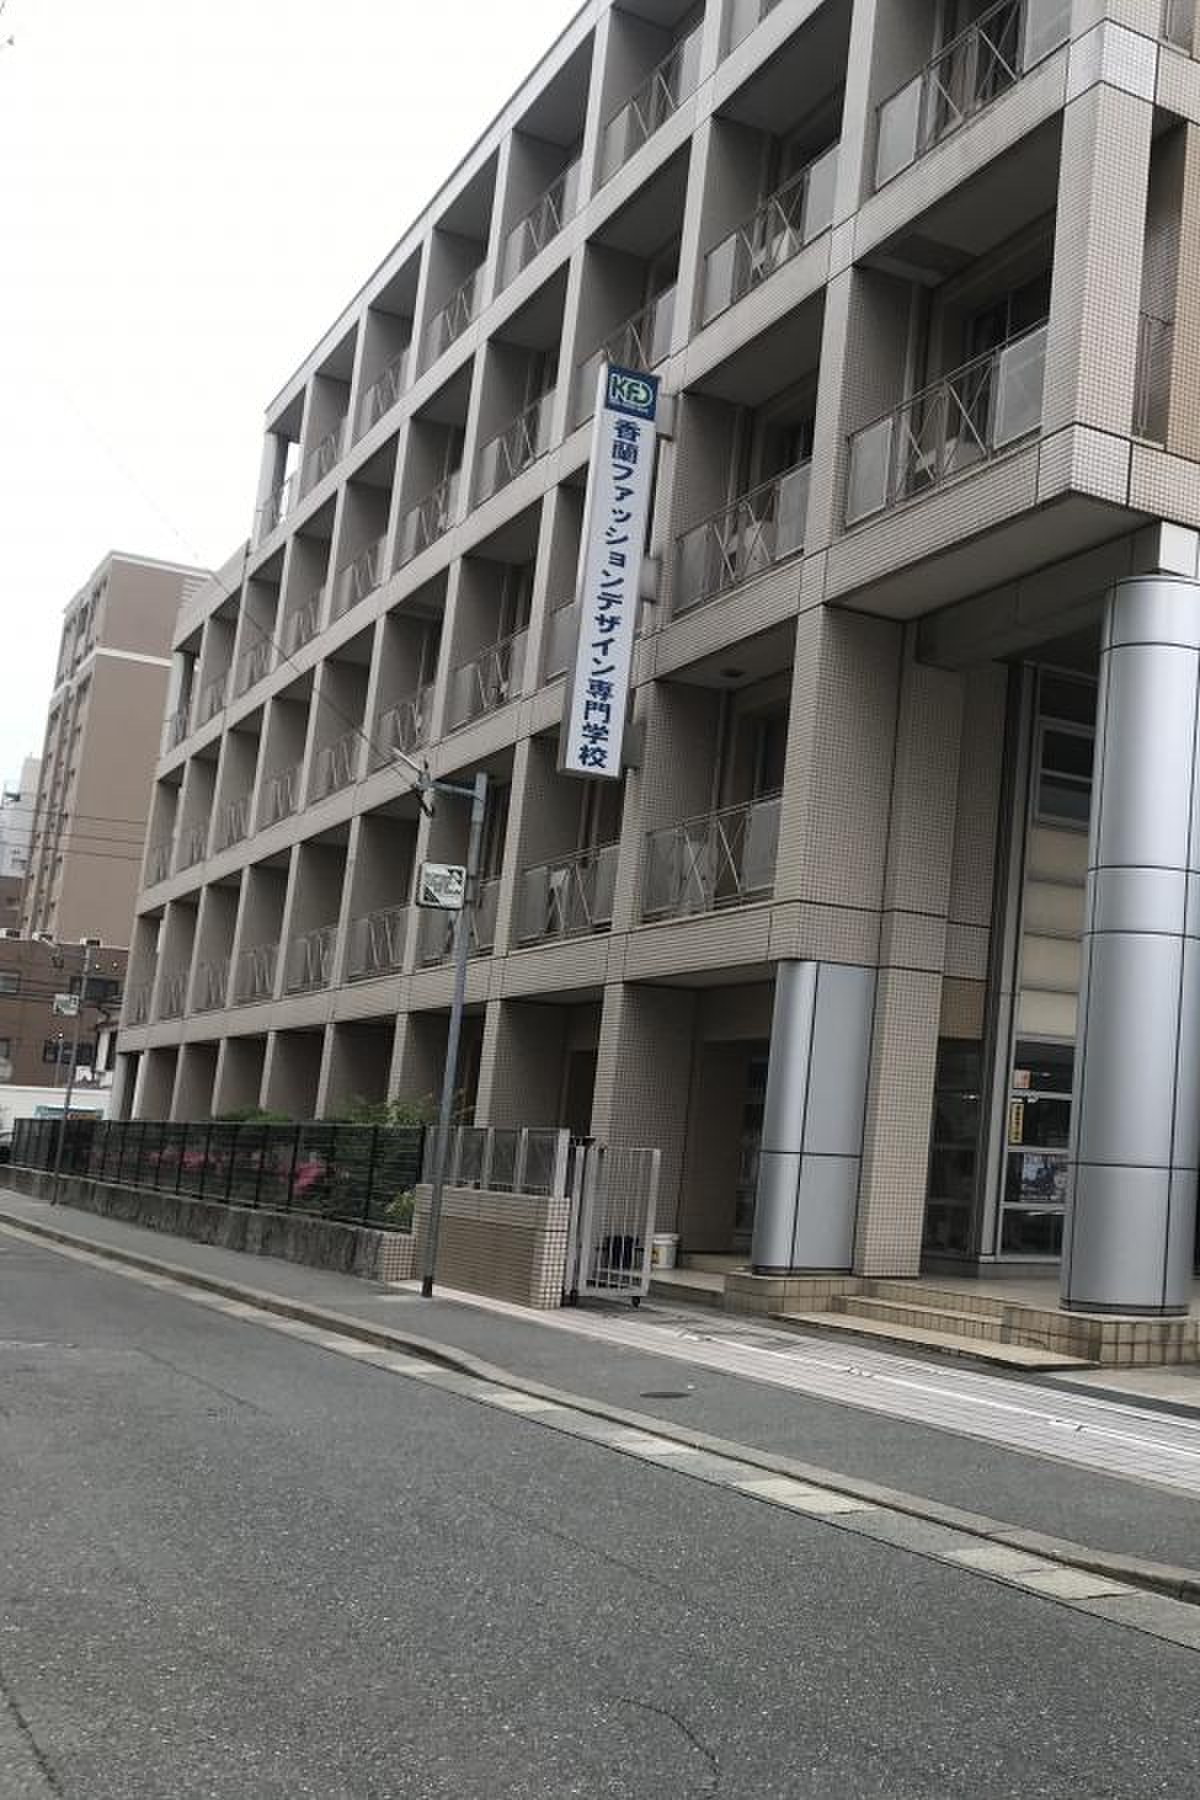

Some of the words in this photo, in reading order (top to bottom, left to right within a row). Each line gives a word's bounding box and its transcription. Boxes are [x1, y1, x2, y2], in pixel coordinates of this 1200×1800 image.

[578, 418, 640, 769] 香蘭ファッションデザイン専門学校
